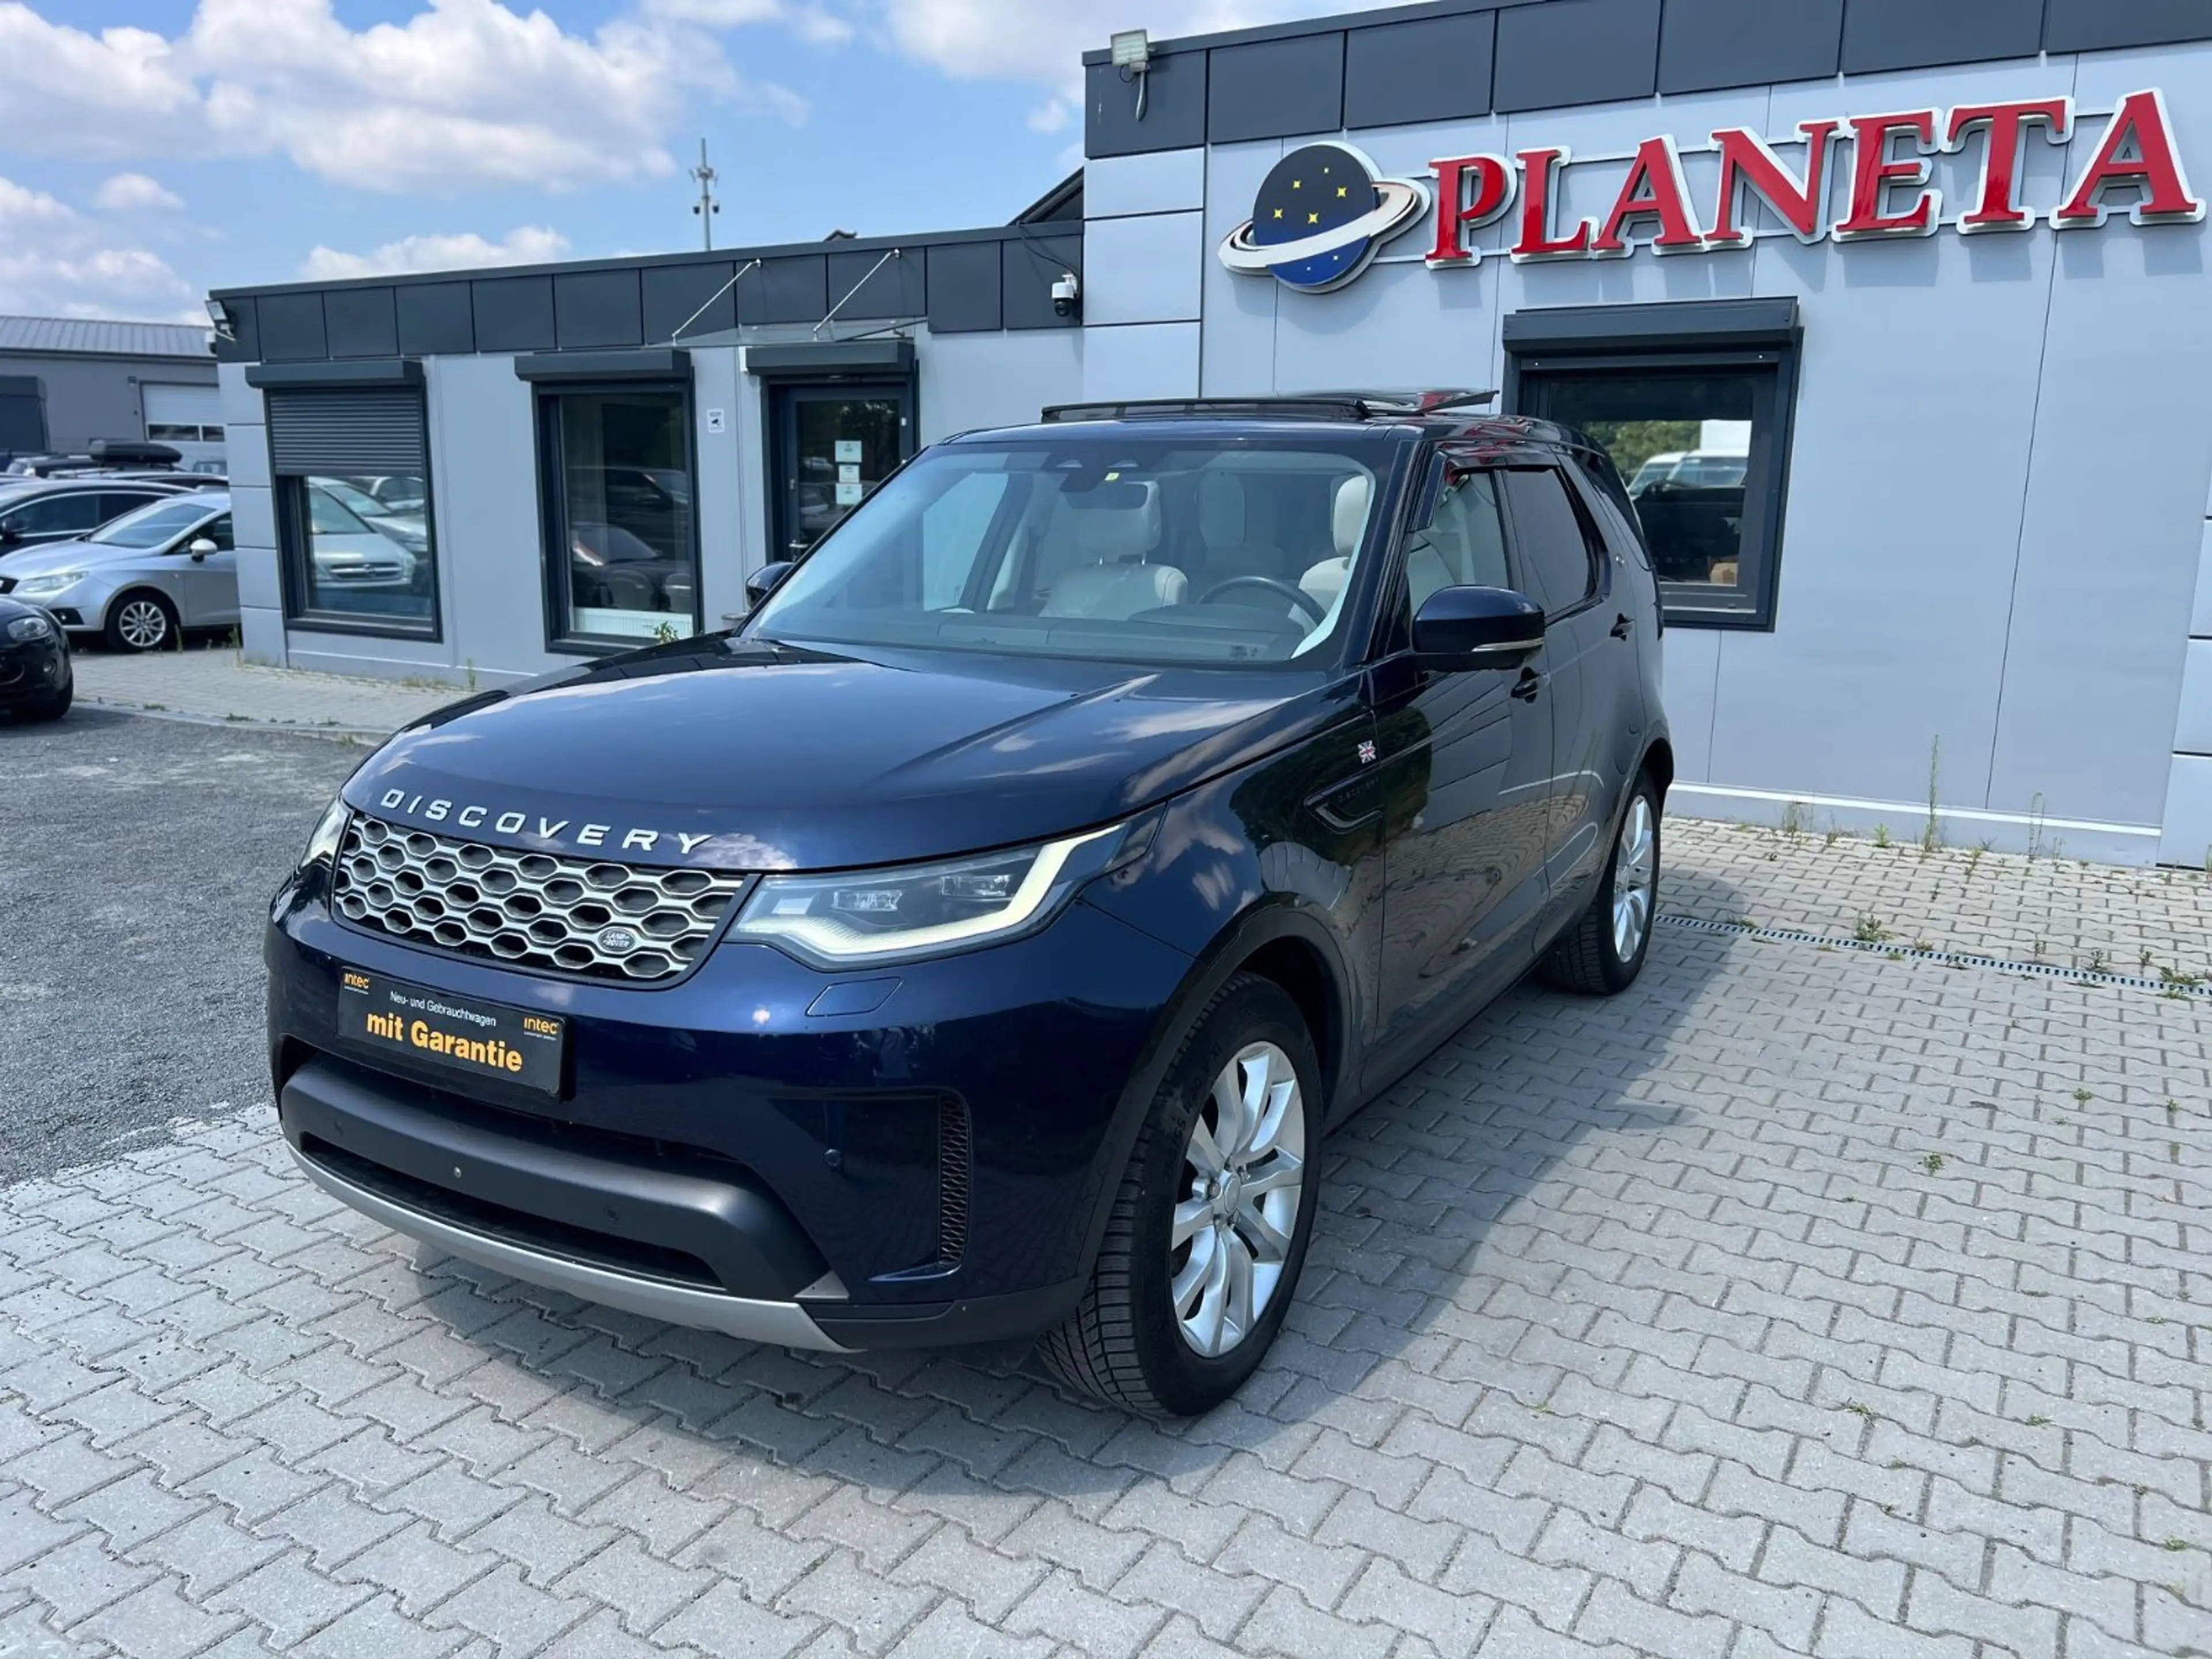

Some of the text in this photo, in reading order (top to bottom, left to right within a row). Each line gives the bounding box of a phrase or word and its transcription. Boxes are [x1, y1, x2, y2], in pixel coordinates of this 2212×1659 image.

[1425, 89, 2199, 263] PLANETA
[380, 788, 714, 854] DISCOVERY
[367, 1012, 522, 1072] mit Garantie
[410, 998, 425, 1009] und
[427, 1000, 497, 1027] Gebrauchtwagen
